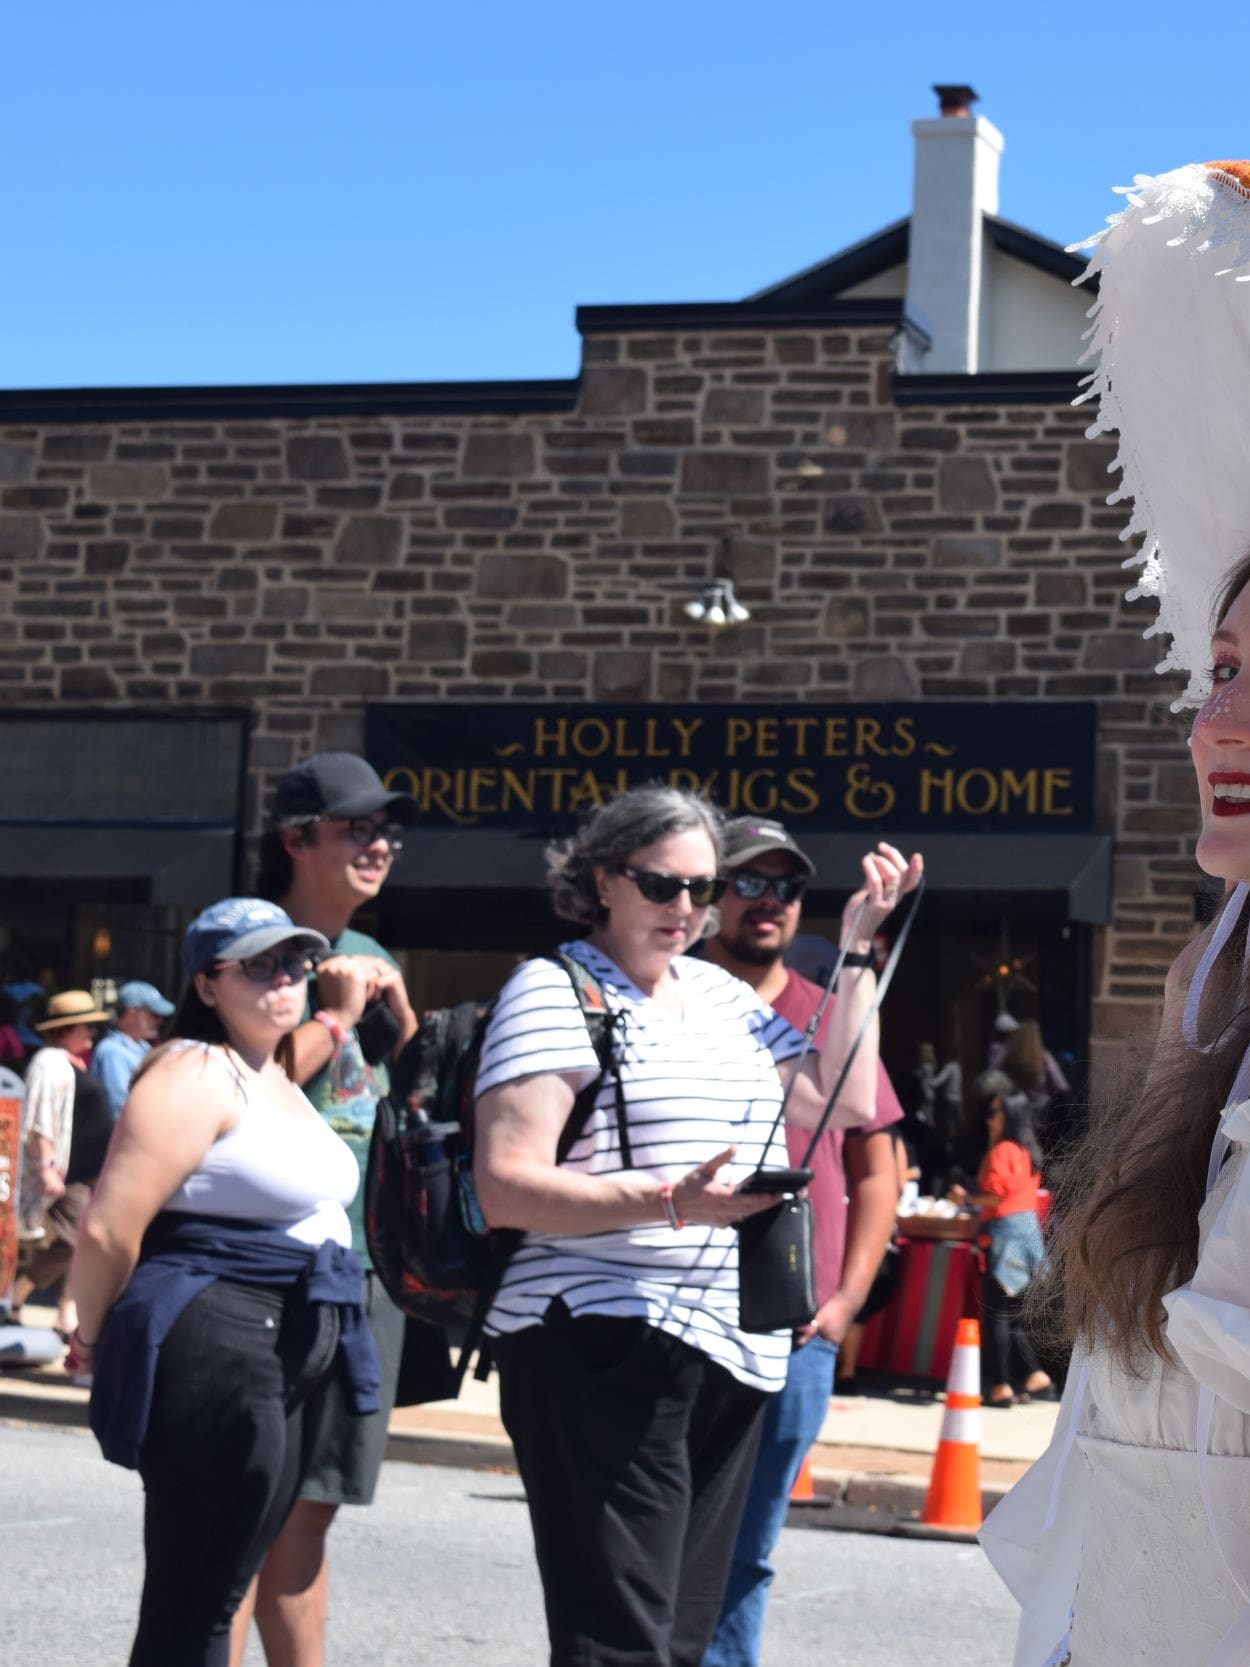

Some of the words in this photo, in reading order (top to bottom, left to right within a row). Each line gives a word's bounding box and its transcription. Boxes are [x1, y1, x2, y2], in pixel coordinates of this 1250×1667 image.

[533, 718, 703, 757] HOLLY
[724, 718, 916, 757] PETERS
[843, 763, 896, 819] &
[918, 767, 1074, 815] HOME
